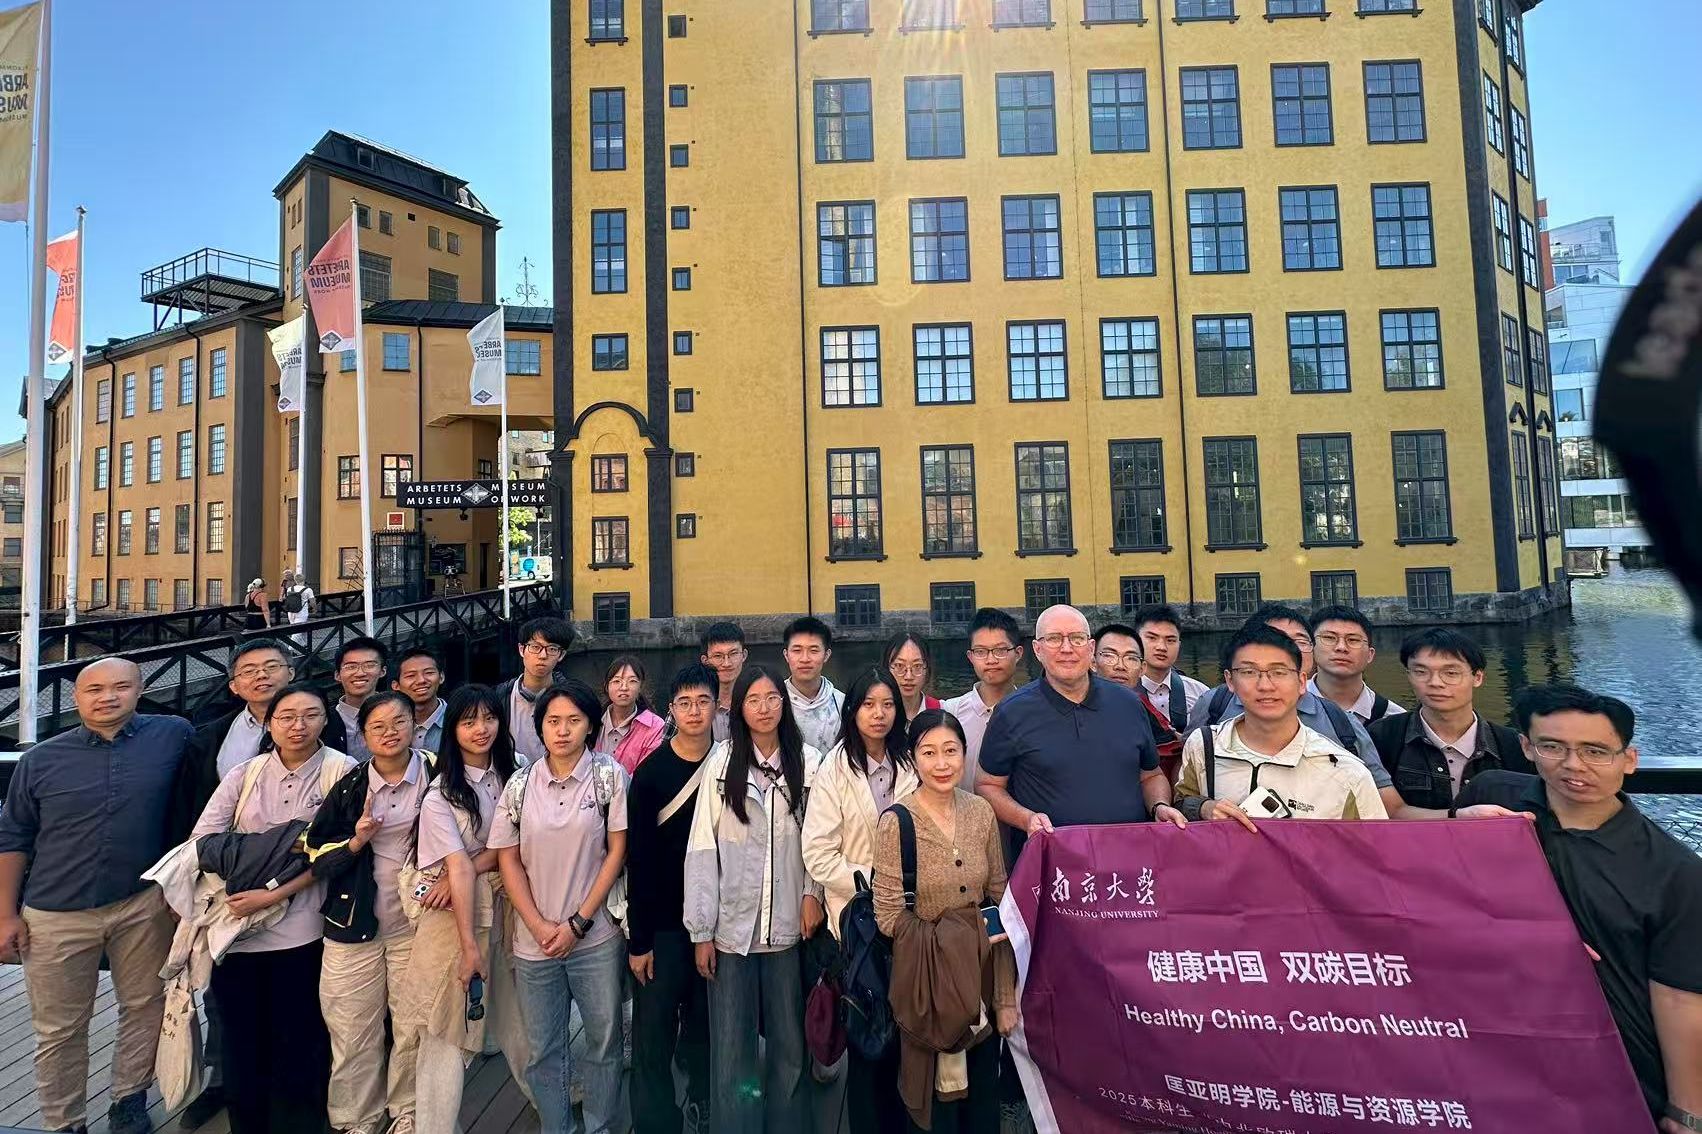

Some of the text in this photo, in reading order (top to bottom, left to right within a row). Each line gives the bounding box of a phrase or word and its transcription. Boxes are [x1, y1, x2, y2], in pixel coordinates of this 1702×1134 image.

[406, 496, 462, 505] MUSEUM
[510, 494, 545, 503] WORK
[407, 482, 546, 493] ARBETETS MSEUM
[1055, 906, 1159, 919] NANJING UNIVERSITY
[1147, 950, 1412, 987] 健康中国 双碳目标
[1124, 1003, 1469, 1040] Healthy China, Carbon Neutral
[1164, 1074, 1473, 1130] 匡亚明学院-能源与资源学院
